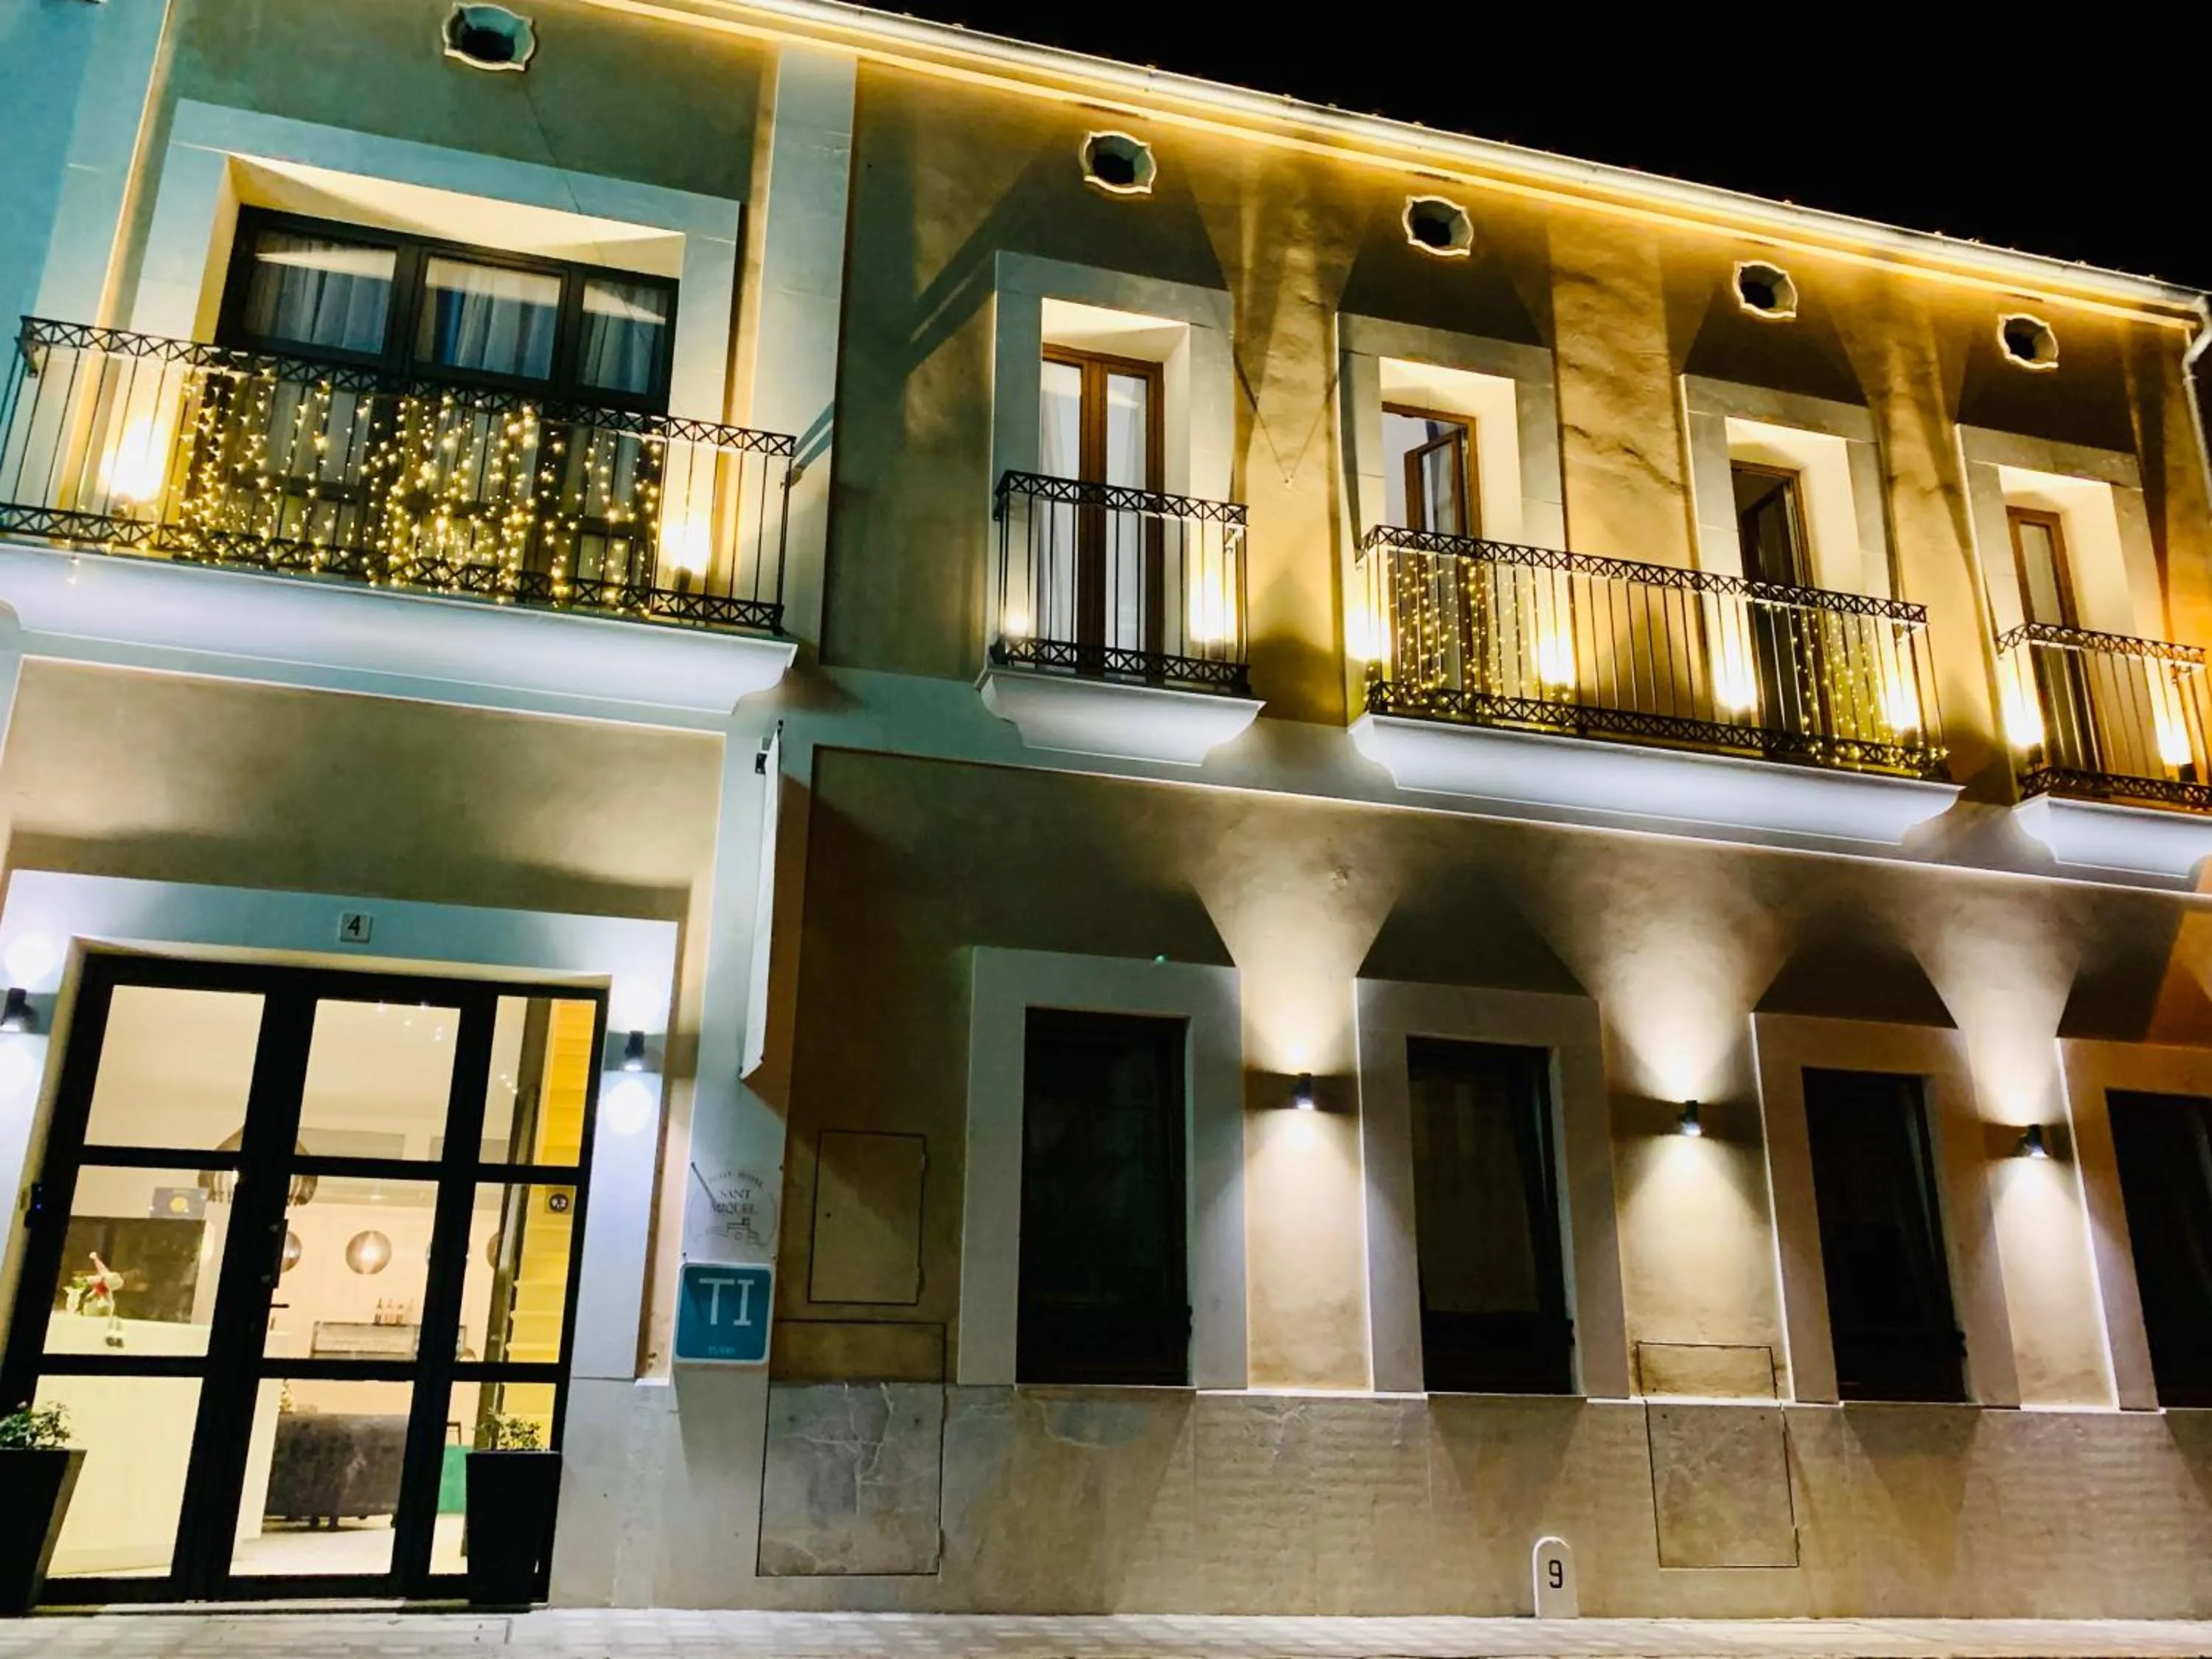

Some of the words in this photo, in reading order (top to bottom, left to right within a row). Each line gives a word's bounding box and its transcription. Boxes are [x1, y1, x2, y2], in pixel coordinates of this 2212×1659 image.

[347, 915, 360, 936] 4
[699, 1277, 754, 1326] TI
[1549, 1559, 1562, 1589] 9
